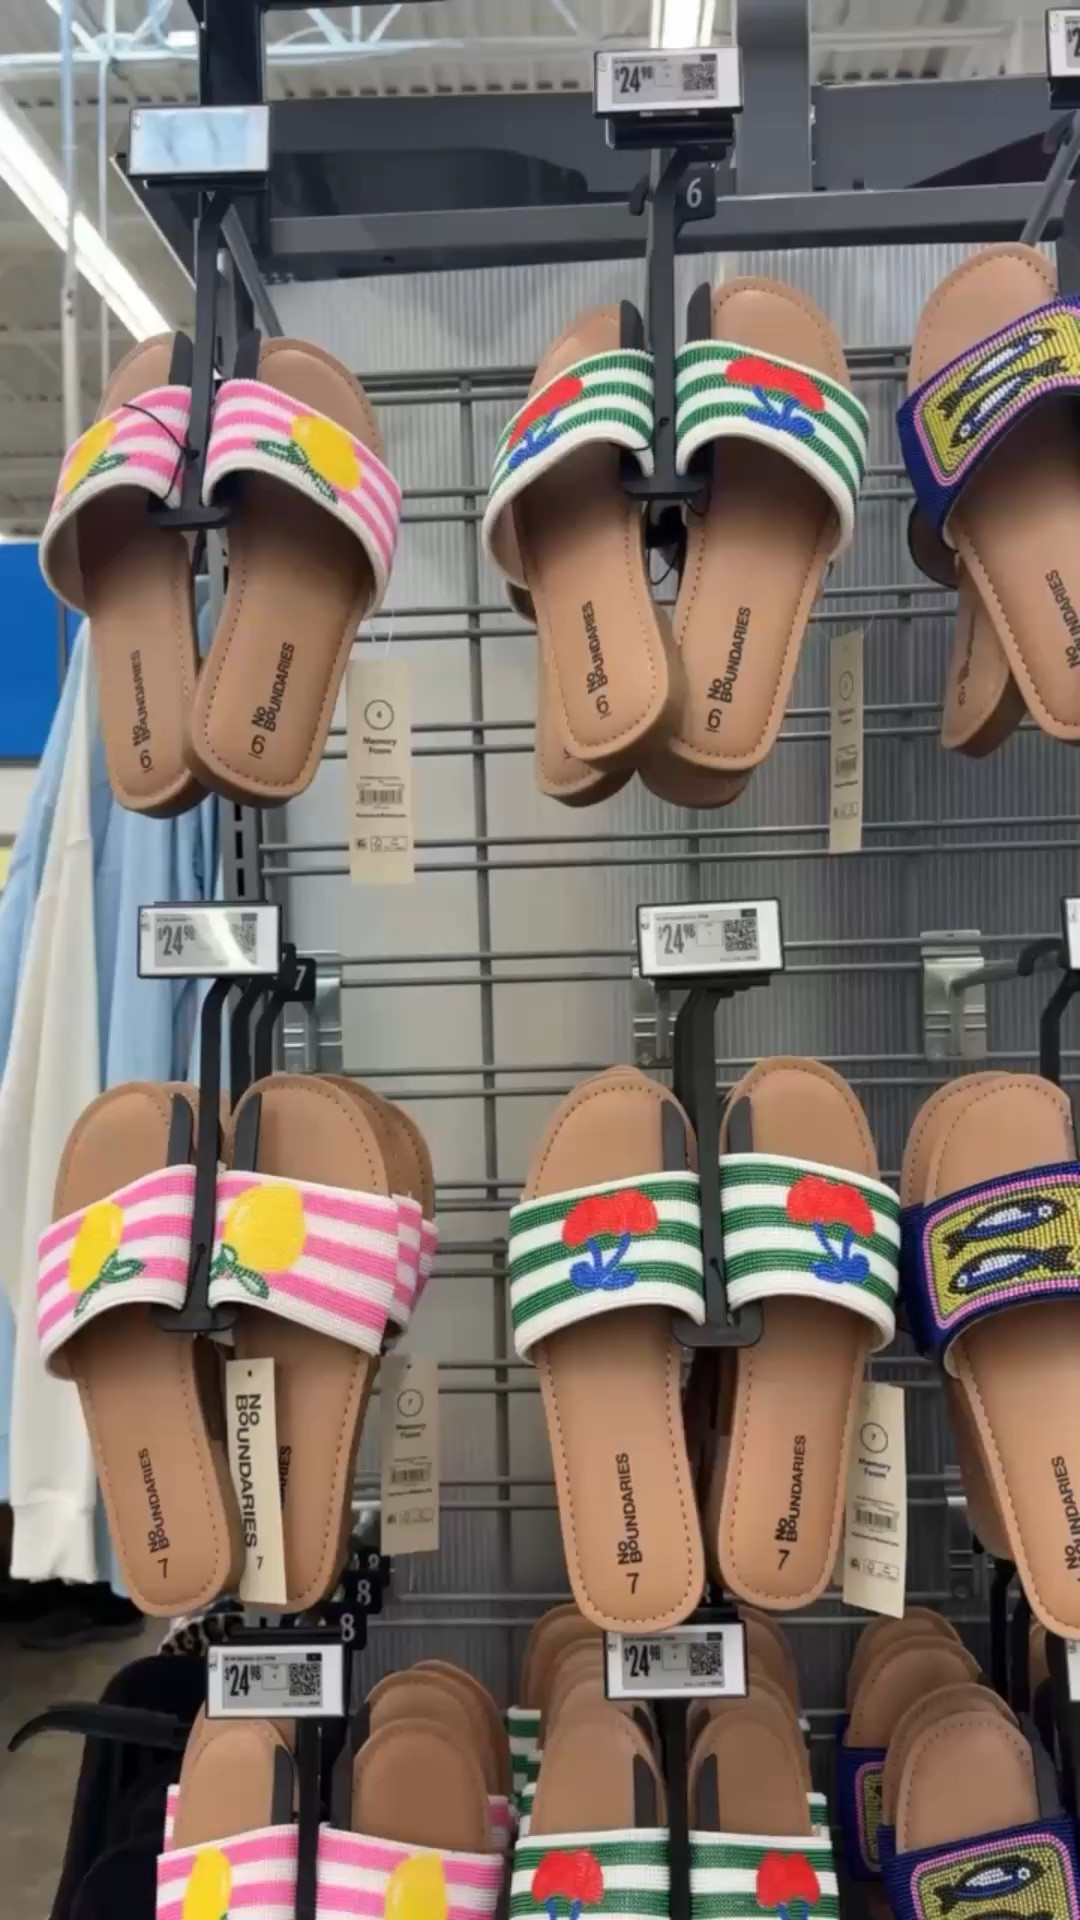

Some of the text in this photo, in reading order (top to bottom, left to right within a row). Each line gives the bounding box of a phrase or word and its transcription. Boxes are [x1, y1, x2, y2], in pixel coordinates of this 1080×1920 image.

[686, 177, 702, 208] 6
[581, 600, 608, 688] BOUNDARIES
[720, 606, 751, 703] BOUNDARIES
[264, 641, 295, 732] BOUNDARIES
[250, 1393, 262, 1426] NO
[236, 1394, 258, 1548] BOUNDARIES
[138, 1448, 171, 1551] BOUNDARIES
[785, 1434, 806, 1542] BOUNDARIES
[615, 1452, 642, 1563] BOUNDARIES
[256, 1556, 264, 1570] 7
[617, 1540, 630, 1565] NO
[778, 1549, 790, 1571] 7
[1064, 1545, 1079, 1570] NO
[157, 1558, 169, 1579] 7
[626, 1572, 640, 1594] 7
[357, 1579, 372, 1605] 8
[340, 1613, 355, 1642] 8
